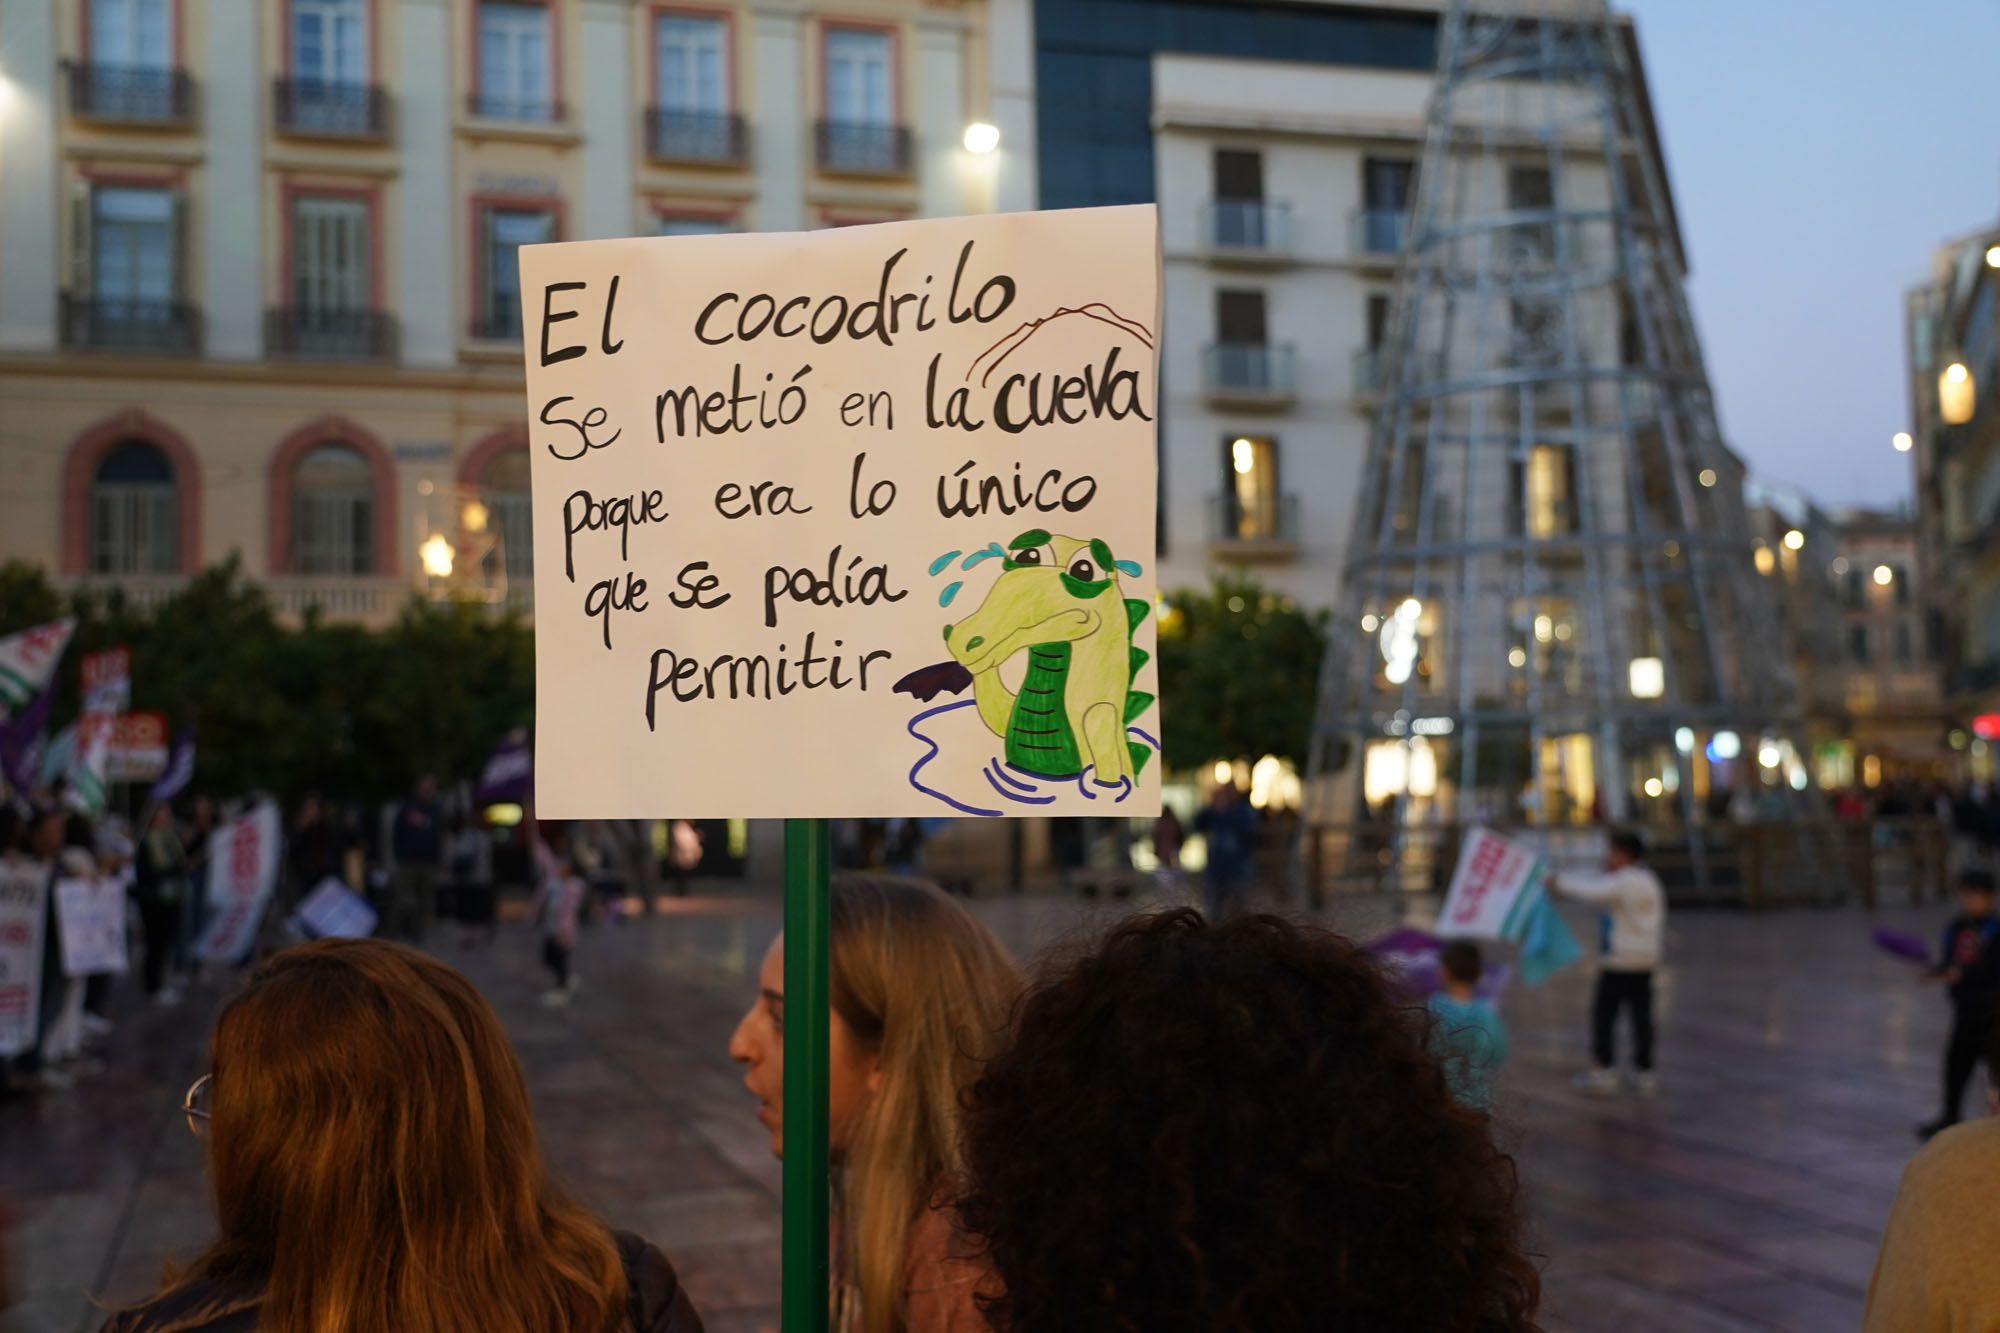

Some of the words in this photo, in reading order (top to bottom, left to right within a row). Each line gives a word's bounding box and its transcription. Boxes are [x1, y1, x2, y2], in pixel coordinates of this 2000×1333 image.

[540, 275, 624, 368] El
[694, 239, 1017, 347] cocodrilo
[655, 363, 813, 444] metió
[840, 390, 893, 431] en
[926, 352, 986, 432] la
[563, 489, 669, 584] porque
[714, 480, 813, 520] era
[850, 452, 897, 519] lo
[937, 459, 1097, 519] único
[584, 571, 649, 650] que
[764, 544, 909, 628] podía
[645, 631, 892, 732] permitir
